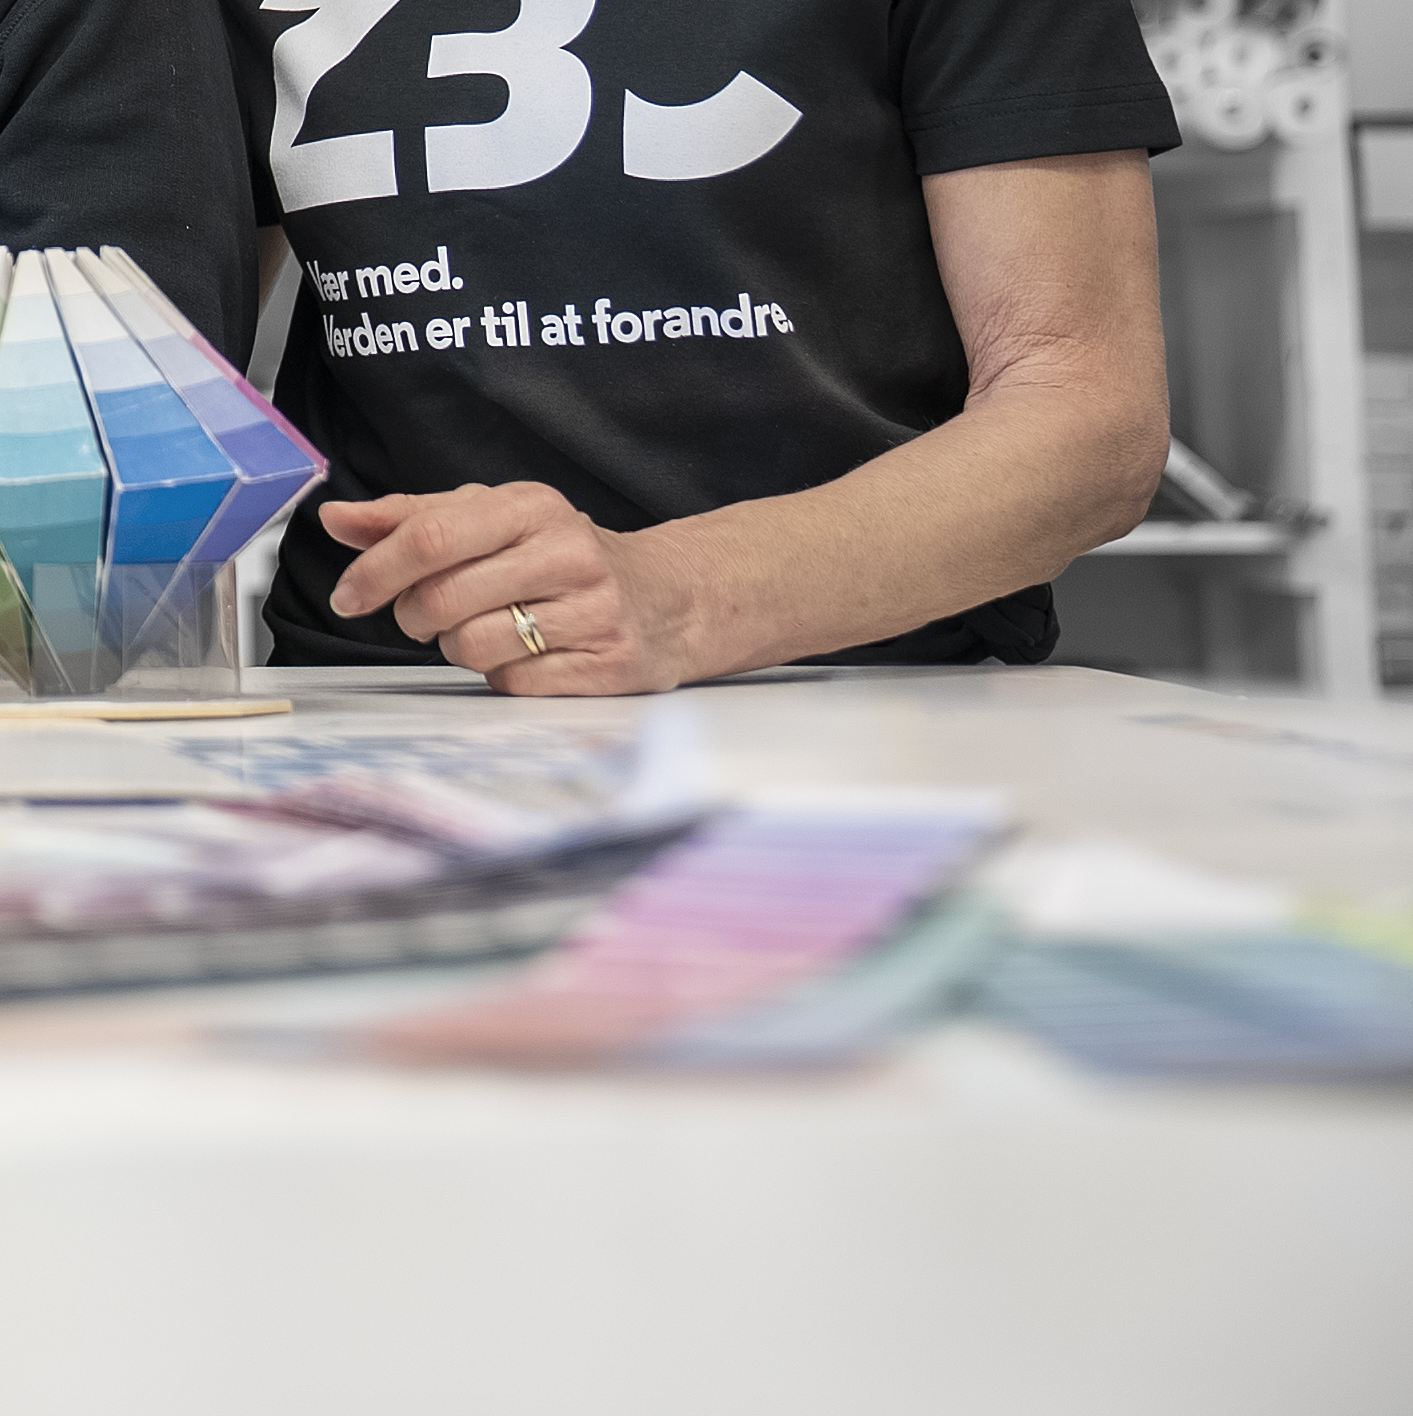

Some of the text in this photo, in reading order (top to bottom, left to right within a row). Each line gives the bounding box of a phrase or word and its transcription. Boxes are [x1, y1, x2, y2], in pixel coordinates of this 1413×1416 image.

[306, 245, 465, 302] Vær med.
[323, 311, 420, 358] Verden
[425, 316, 472, 351] er
[480, 300, 532, 348] til
[540, 304, 586, 346] at
